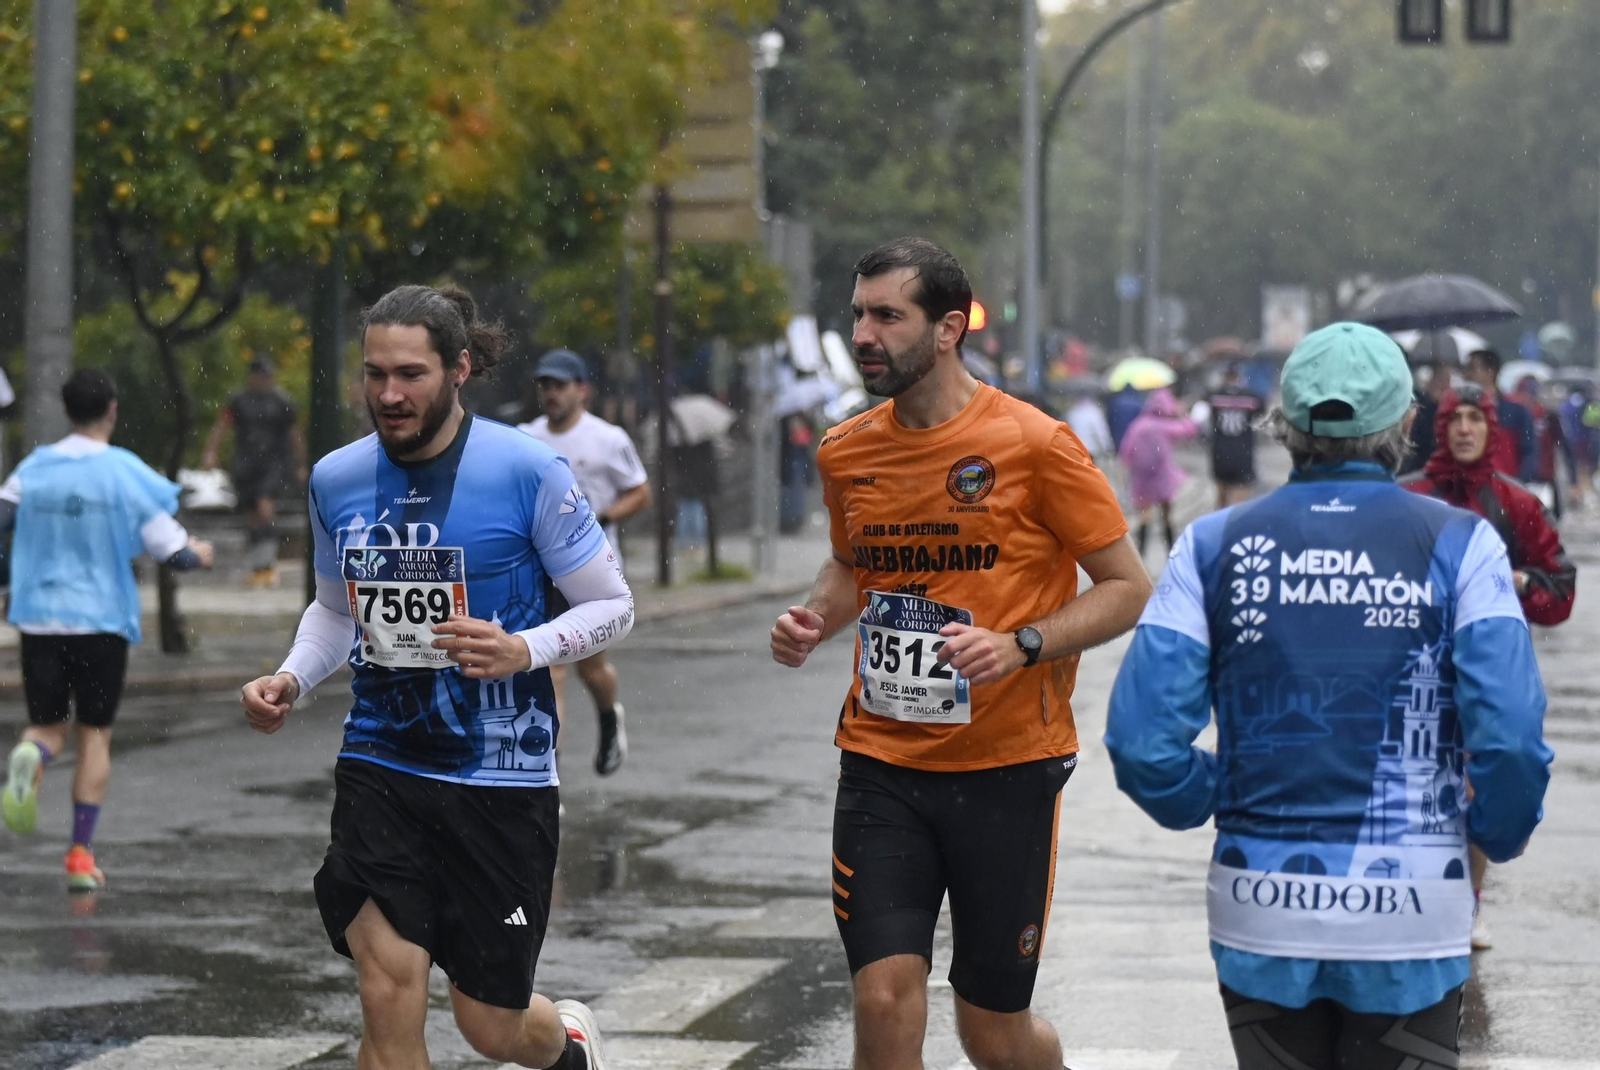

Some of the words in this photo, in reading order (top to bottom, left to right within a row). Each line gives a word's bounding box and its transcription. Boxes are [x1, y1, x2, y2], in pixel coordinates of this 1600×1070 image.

[393, 496, 431, 505] TEAMERGY
[863, 524, 886, 537] CLUB
[889, 524, 902, 536] DE
[904, 523, 959, 536] ATLETISMO
[399, 551, 438, 562] MEDIA
[1280, 549, 1375, 576] MEDIA
[398, 560, 438, 571] MARATÓN
[393, 570, 442, 580] CÓRDOBA
[1230, 575, 1271, 606] 39
[1279, 572, 1433, 607] MARATÓN
[358, 587, 451, 625] 7569
[901, 598, 945, 614] MEDIA
[900, 610, 945, 622] MARATÓN
[1364, 607, 1421, 629] 2025
[396, 633, 416, 642] JUAN
[589, 620, 617, 647] JAEN
[869, 631, 953, 680] 3512
[879, 681, 898, 693] JESUS
[901, 686, 928, 697] JAVIER
[914, 706, 951, 715] IMDECO
[1231, 869, 1423, 915] CÓRDOBA
